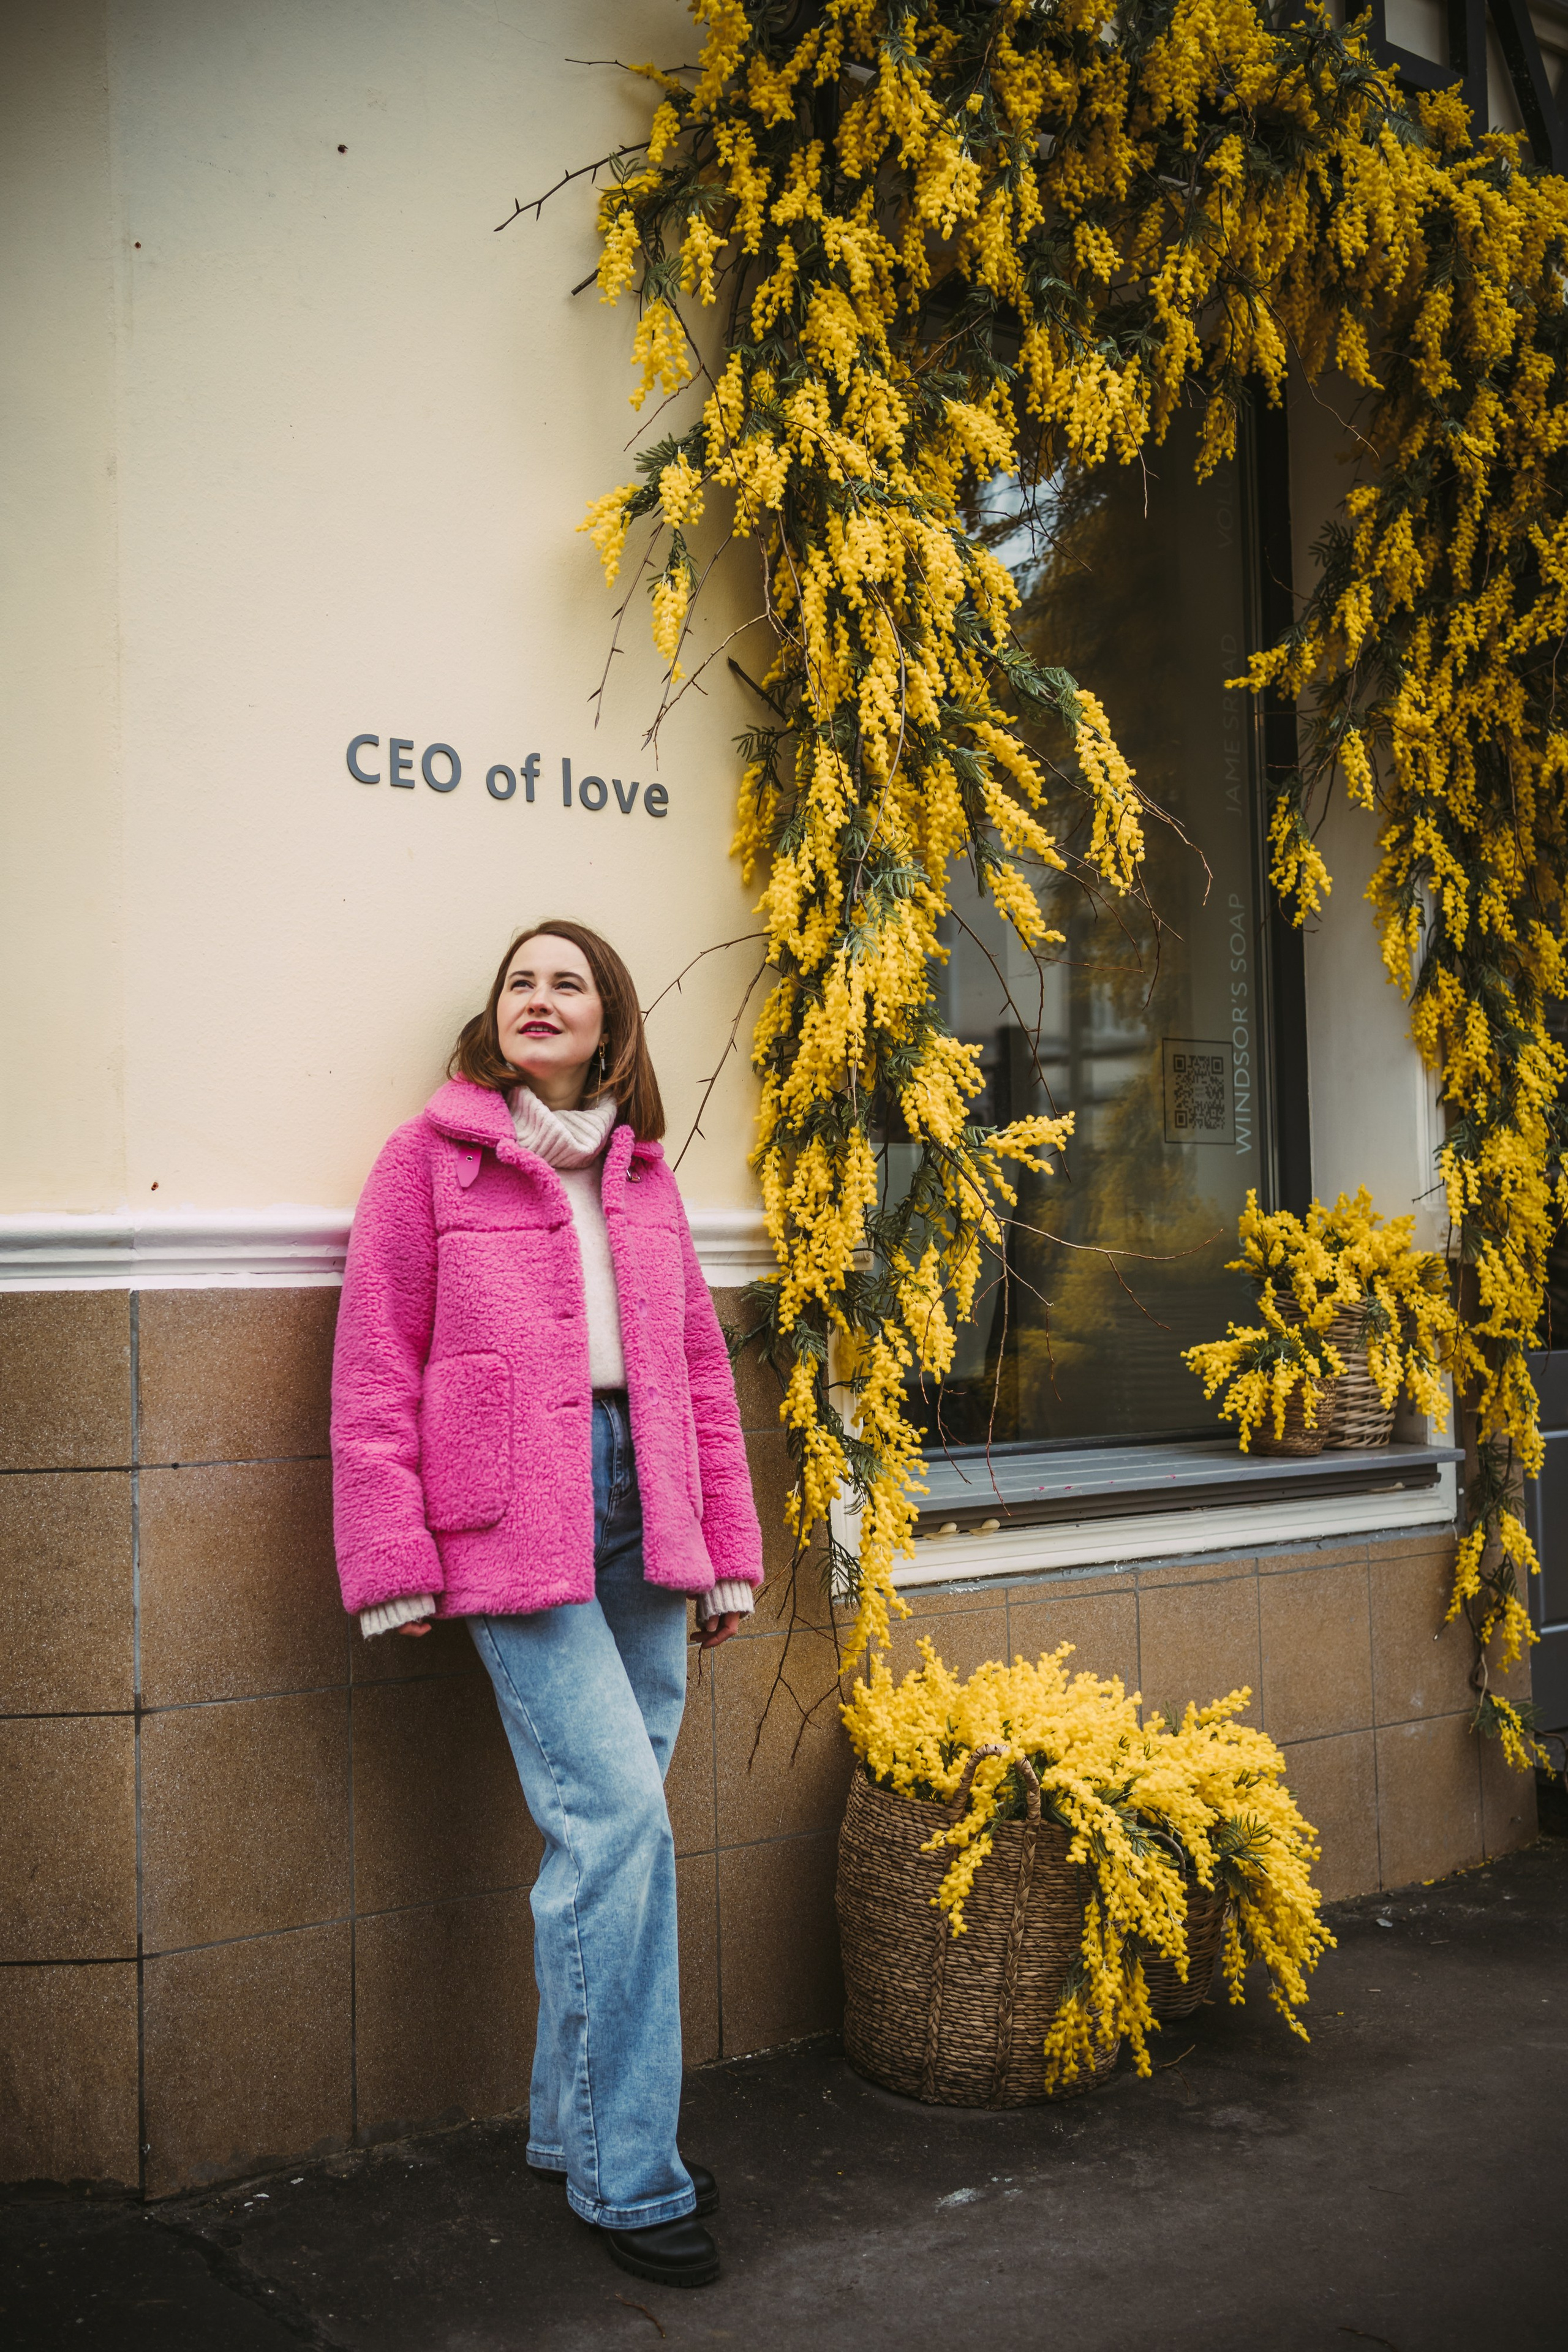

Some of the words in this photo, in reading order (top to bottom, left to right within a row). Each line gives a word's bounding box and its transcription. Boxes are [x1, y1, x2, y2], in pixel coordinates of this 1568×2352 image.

[1215, 468, 1234, 549] VOLU
[1221, 634, 1239, 730] SRAD
[346, 733, 462, 792] CEO
[486, 752, 541, 802] of
[562, 757, 669, 817] love
[1225, 739, 1242, 816] JAME
[1229, 893, 1248, 973] SOAP
[1231, 982, 1252, 1155] WINDSOR'S
